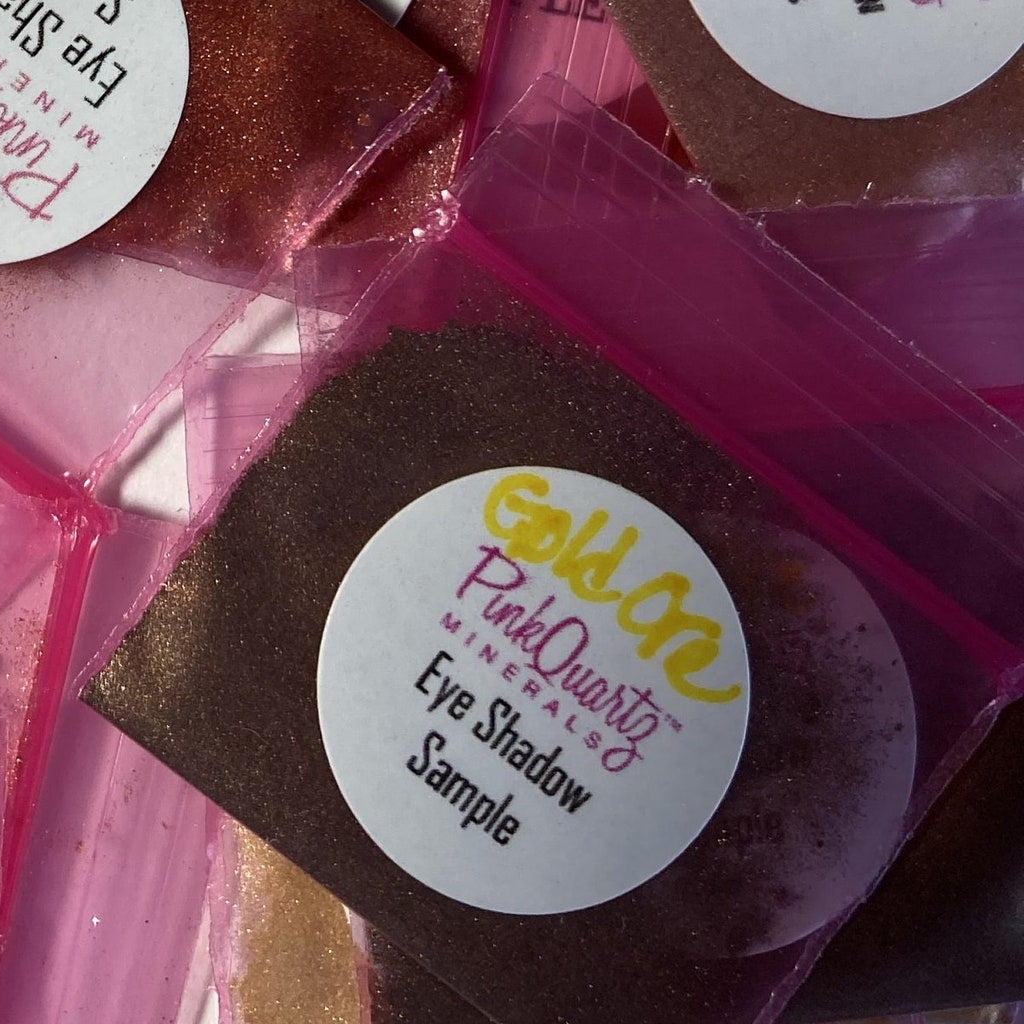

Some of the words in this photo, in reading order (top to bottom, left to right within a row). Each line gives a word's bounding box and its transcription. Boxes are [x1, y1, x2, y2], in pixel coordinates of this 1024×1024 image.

[63, 32, 129, 110] Eye
[484, 473, 639, 603] Gold
[616, 572, 741, 703] Ore
[414, 650, 476, 721] Eye
[472, 697, 592, 814] Shadow
[439, 611, 601, 751] MINERALS
[406, 731, 520, 846] Sample
